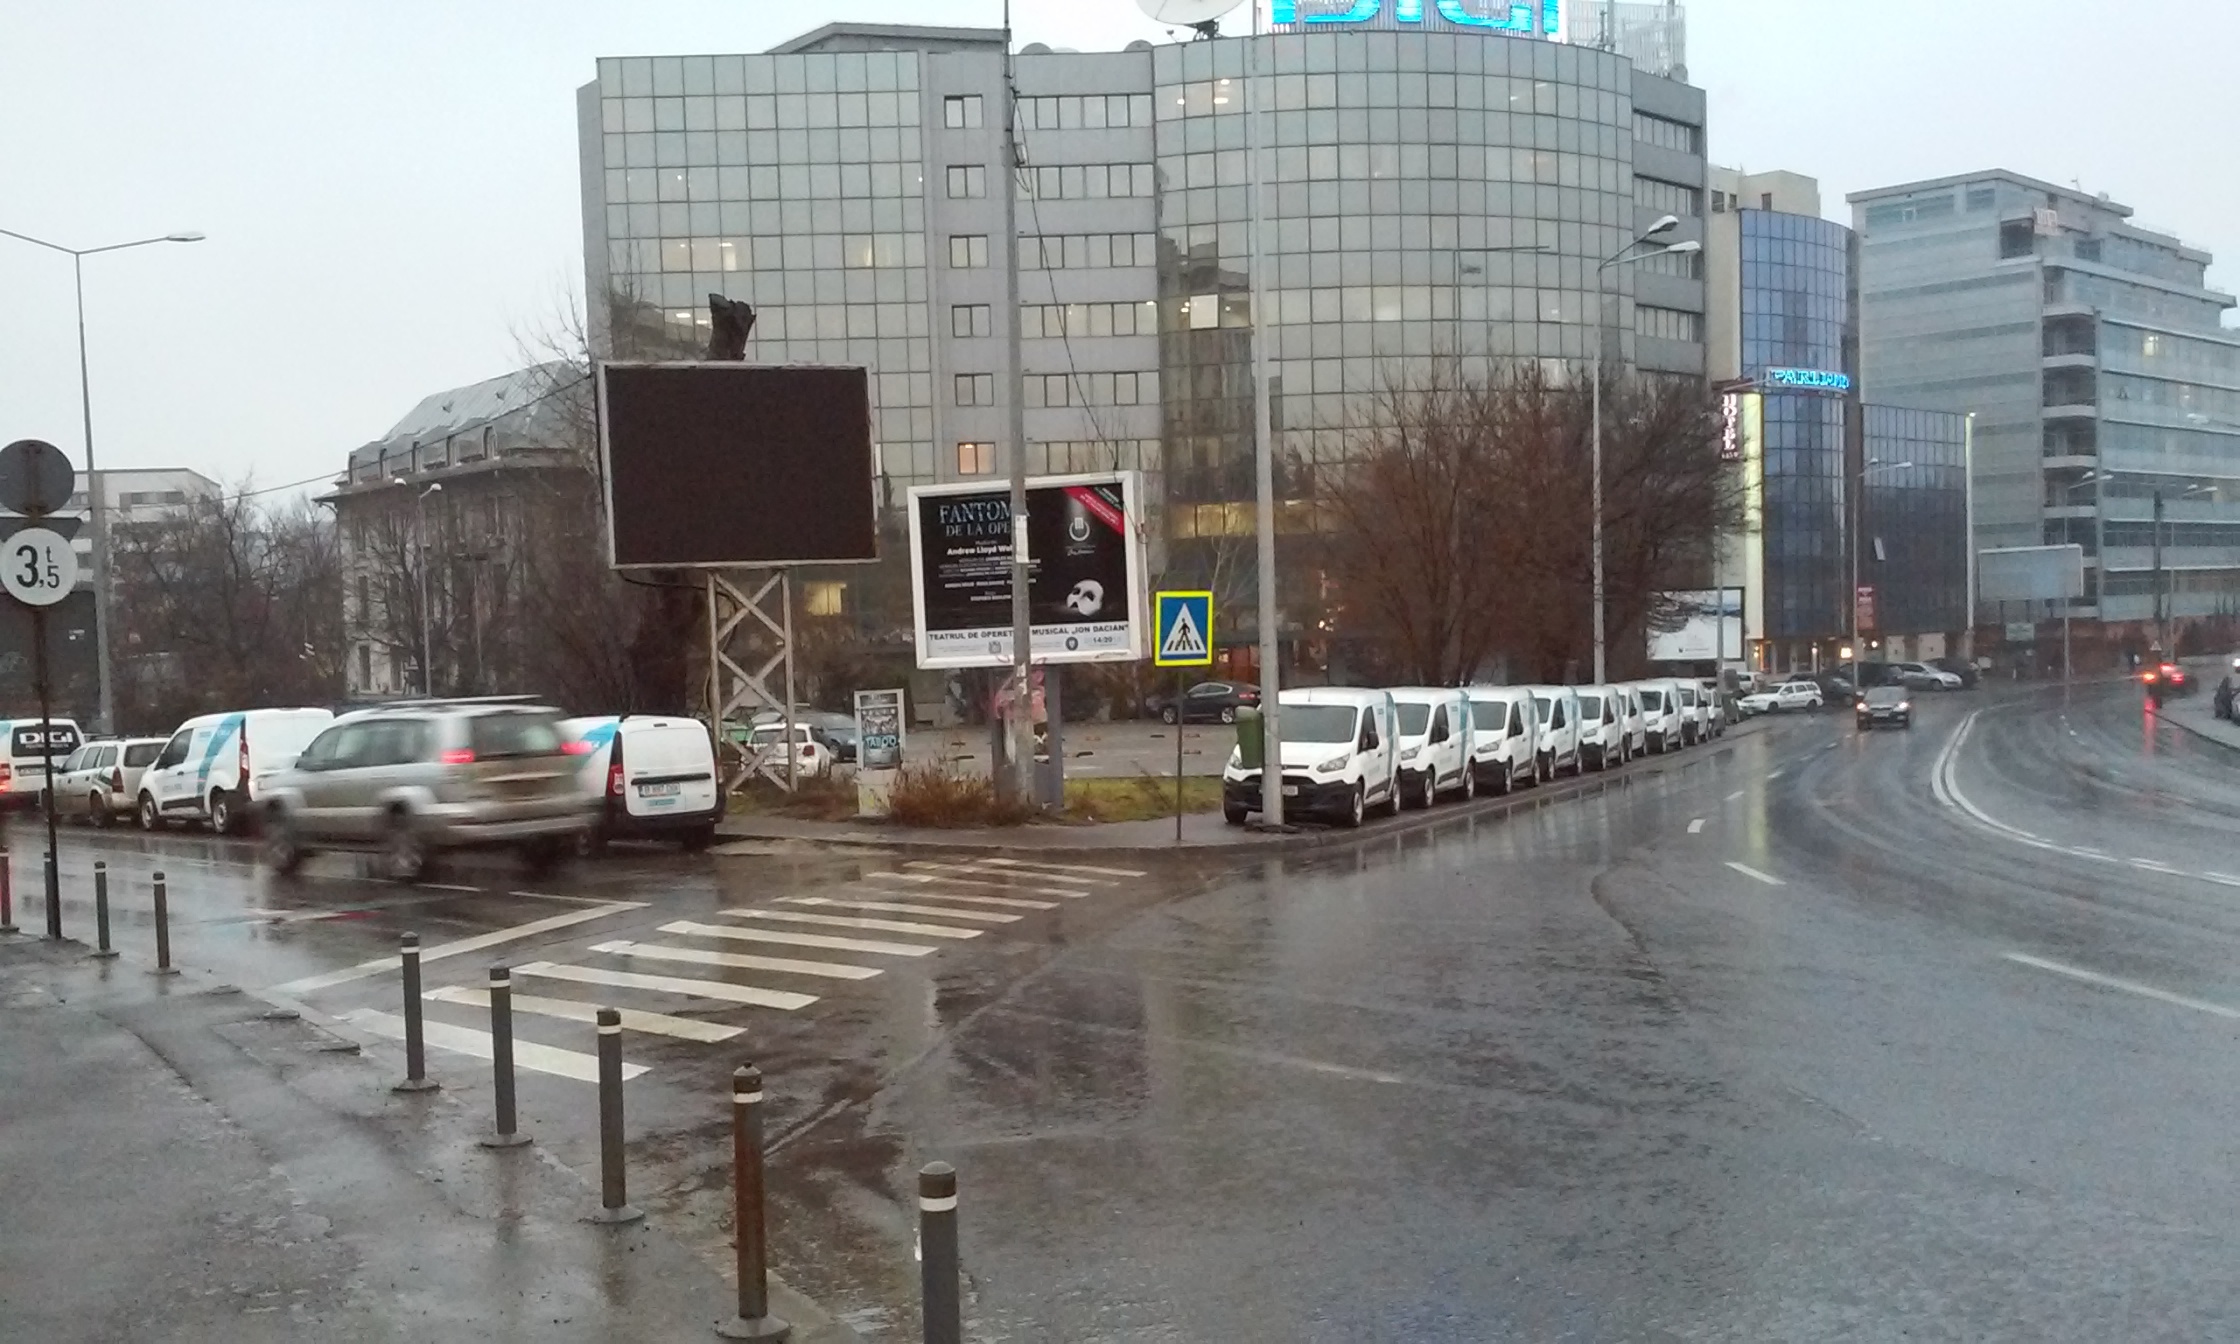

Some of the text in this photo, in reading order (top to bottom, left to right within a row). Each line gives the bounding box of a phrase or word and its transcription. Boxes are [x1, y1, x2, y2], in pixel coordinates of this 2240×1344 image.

[939, 500, 1030, 524] FANTOM
[946, 521, 1011, 537] DE LA OPE
[929, 632, 966, 641] TEATRUL
[967, 631, 980, 639] DE
[981, 630, 1014, 638] OPERET
[1032, 627, 1069, 636] MUSICAL
[19, 732, 74, 744] DIGI
